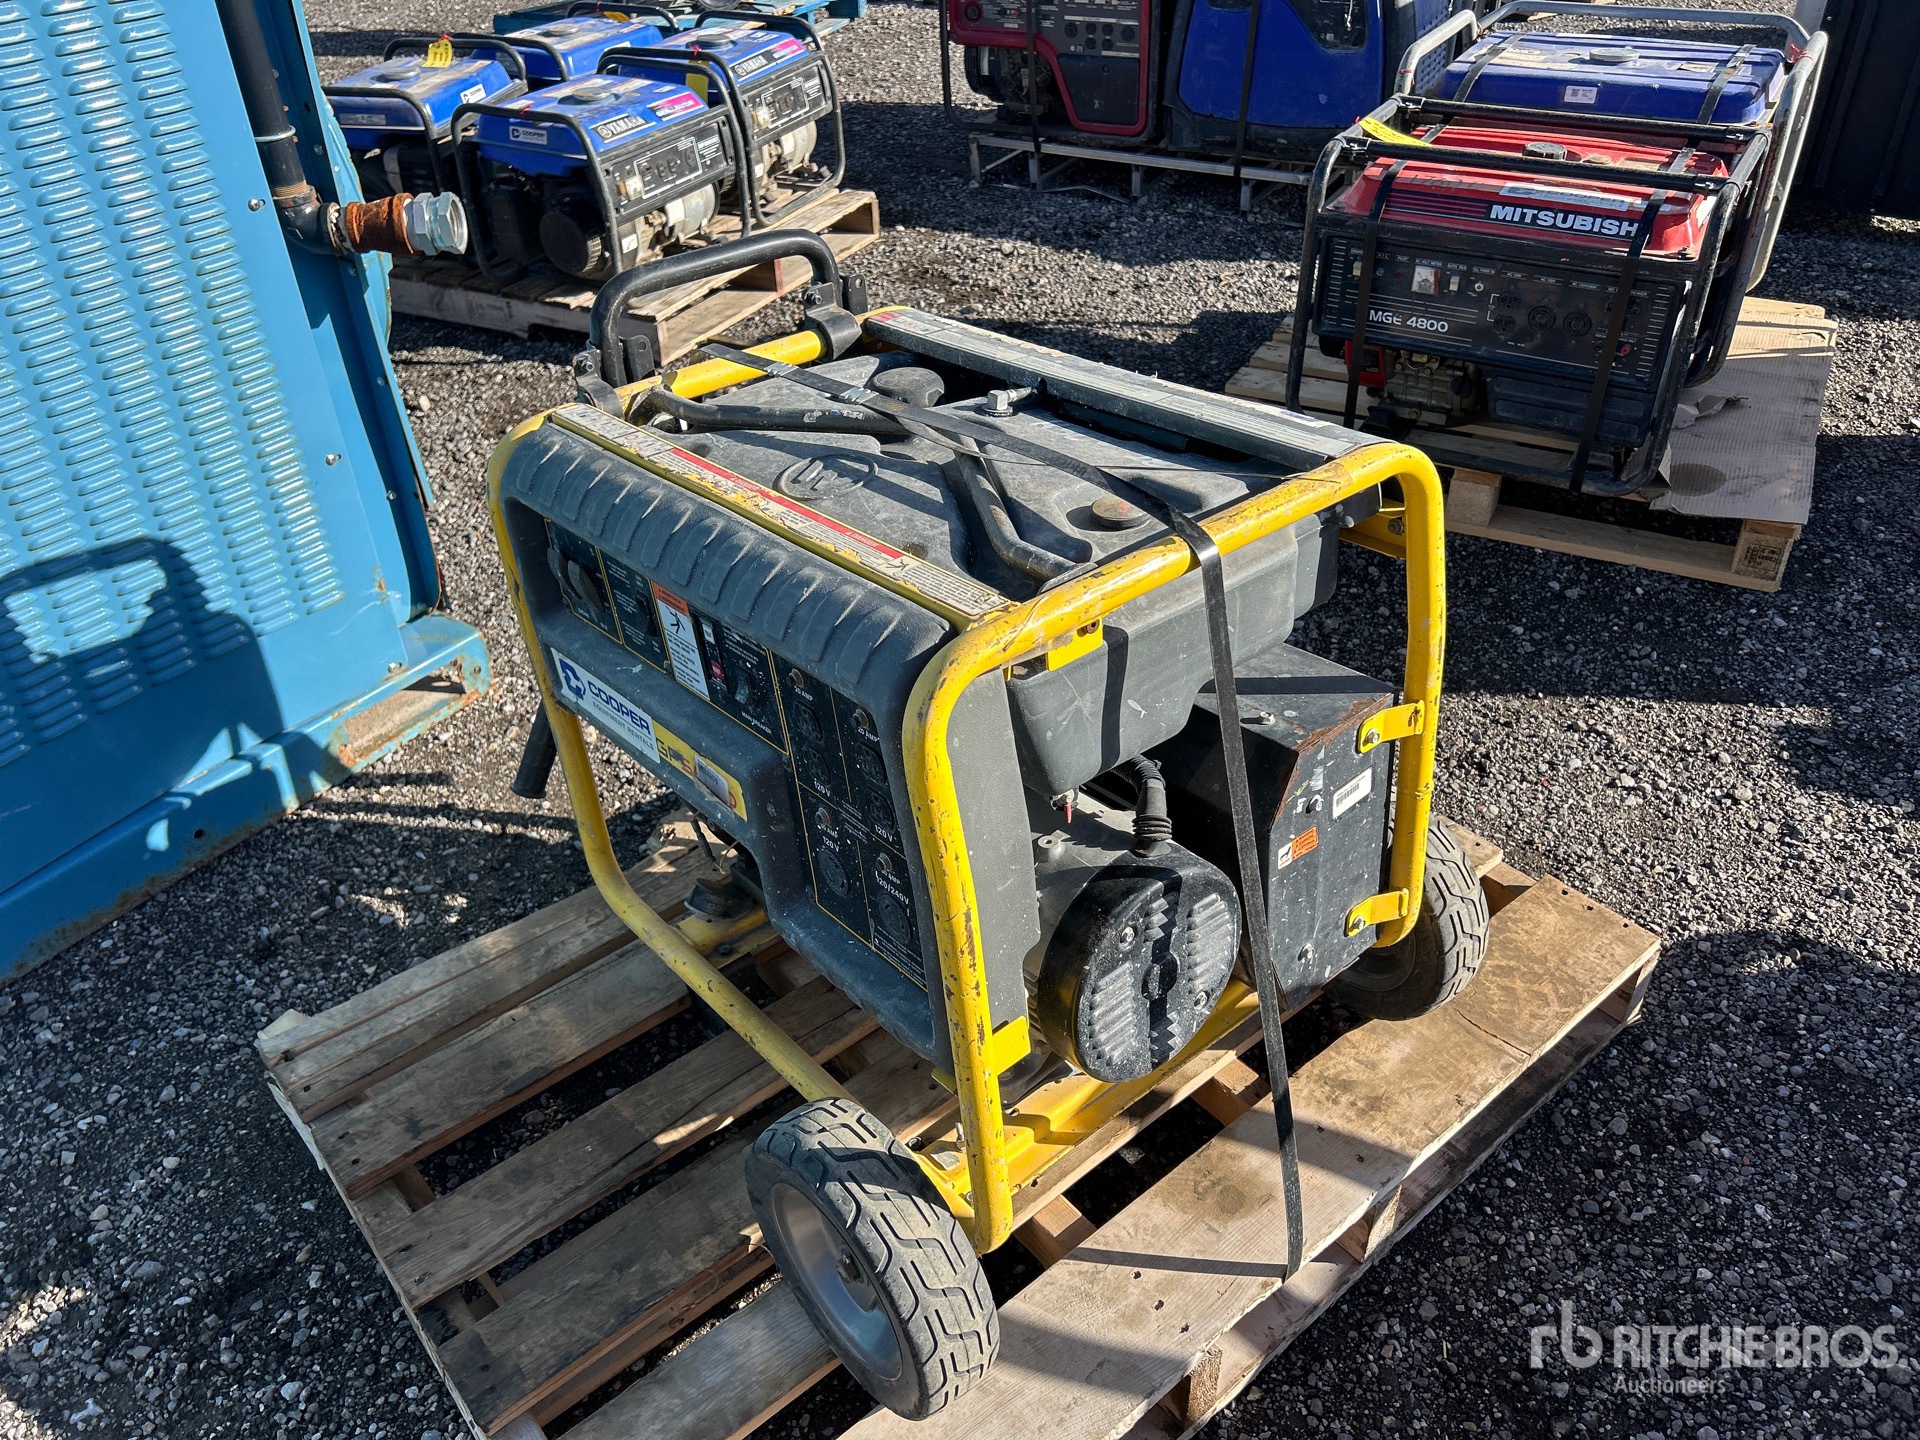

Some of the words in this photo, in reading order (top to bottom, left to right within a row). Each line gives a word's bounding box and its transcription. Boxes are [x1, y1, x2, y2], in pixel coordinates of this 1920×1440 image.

[607, 115, 646, 135] YAMAHA
[1490, 204, 1639, 237] MITSUBISH
[1406, 316, 1449, 333] 4800
[588, 680, 651, 736] COOPER
[627, 725, 655, 752] RENTALS
